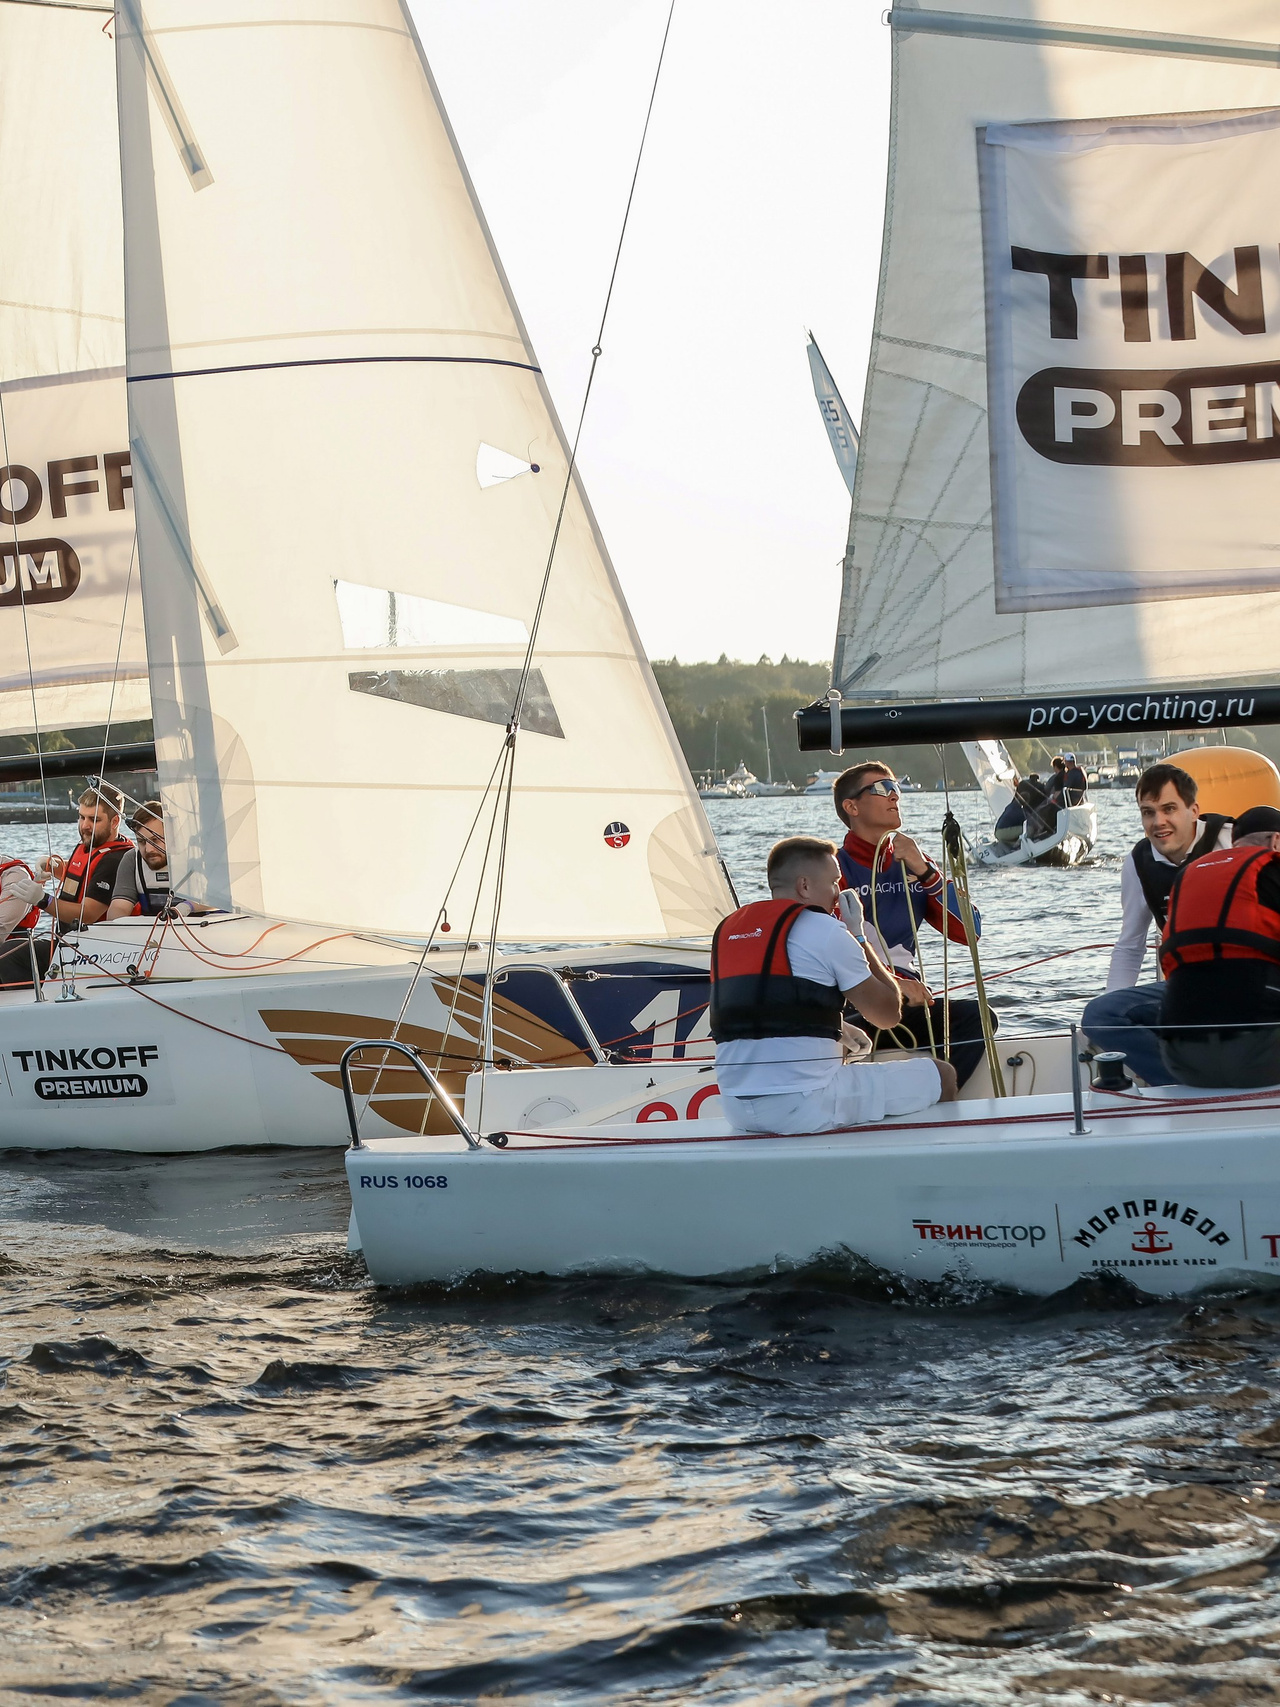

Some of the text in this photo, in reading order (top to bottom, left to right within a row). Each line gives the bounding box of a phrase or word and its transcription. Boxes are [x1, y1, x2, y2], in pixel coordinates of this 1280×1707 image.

[1027, 695, 1255, 732] pro-yachting.ru
[12, 1045, 159, 1072] TINKOFF
[40, 1078, 141, 1096] PREMIUM
[360, 1175, 448, 1189] RUS 1068
[1073, 1199, 1231, 1249] МОРПРИБОР
[1183, 1257, 1217, 1266] ЧАСЫ
